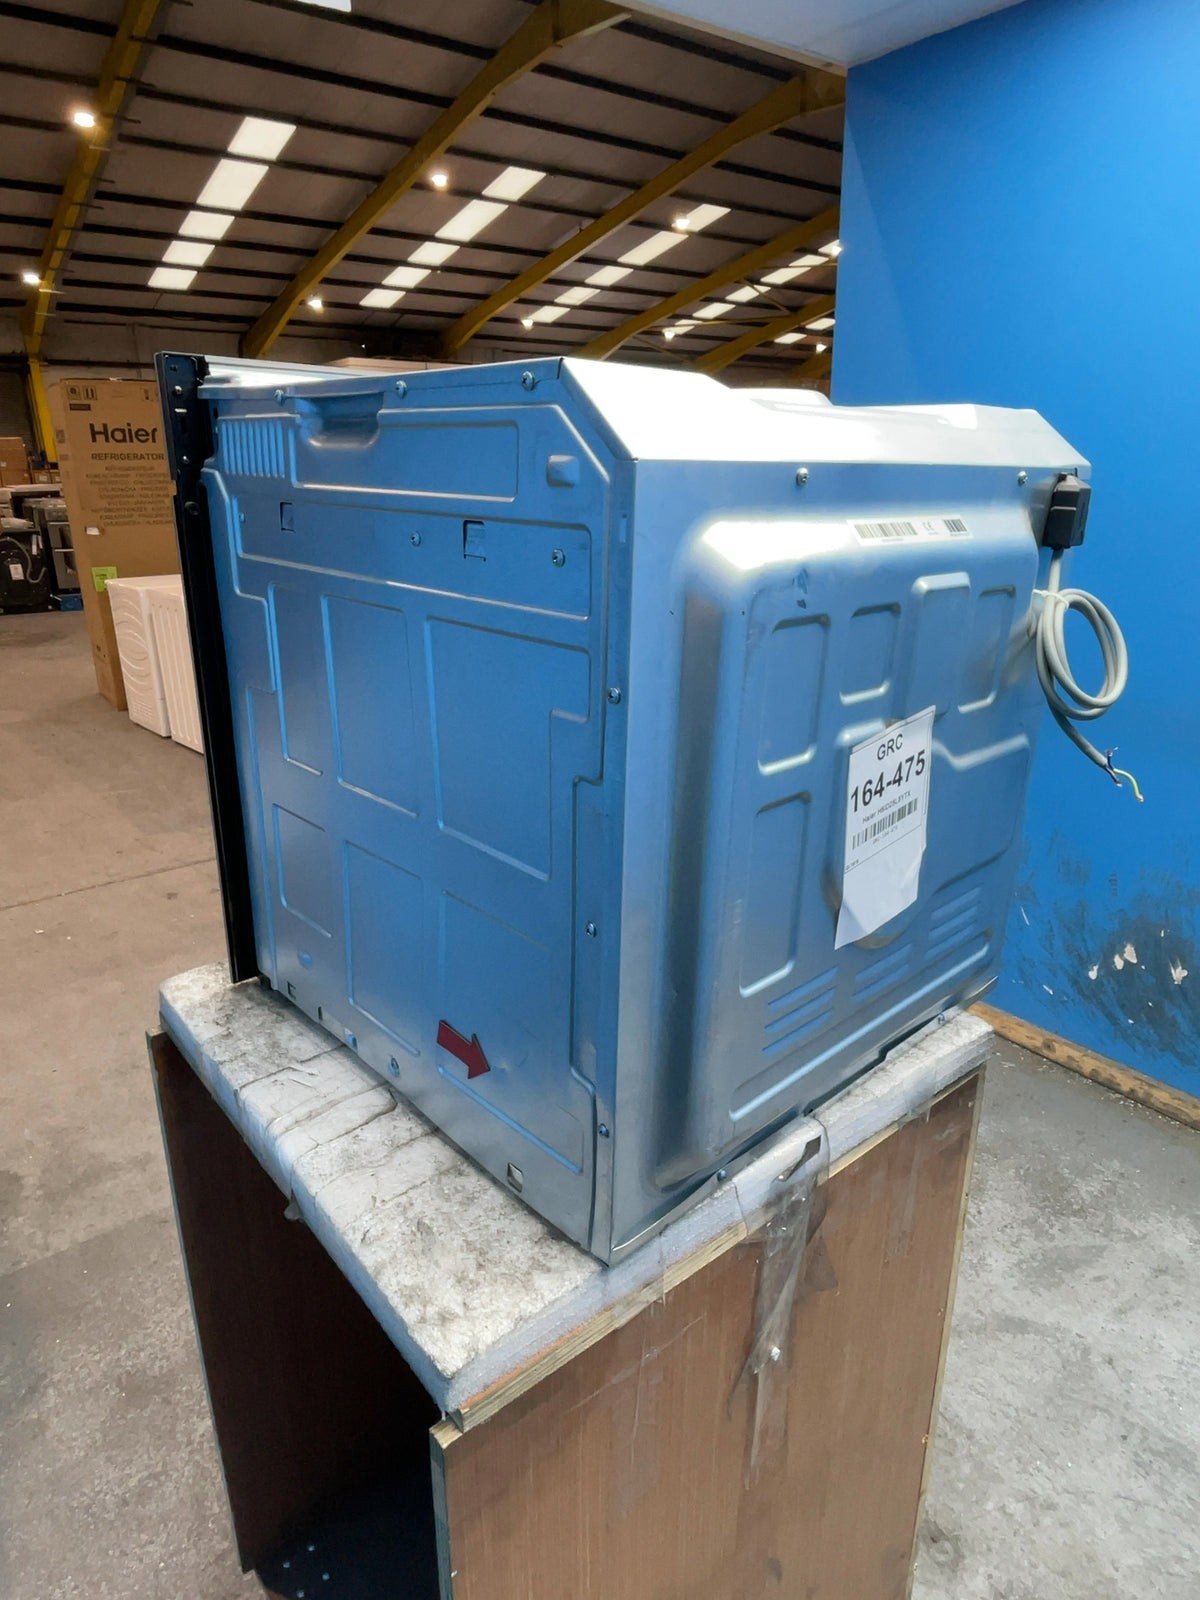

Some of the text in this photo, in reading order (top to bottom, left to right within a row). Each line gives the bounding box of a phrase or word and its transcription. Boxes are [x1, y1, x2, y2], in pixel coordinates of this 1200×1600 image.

[89, 422, 158, 443] Haier
[877, 733, 903, 760] GRC
[850, 749, 925, 813] 164-475
